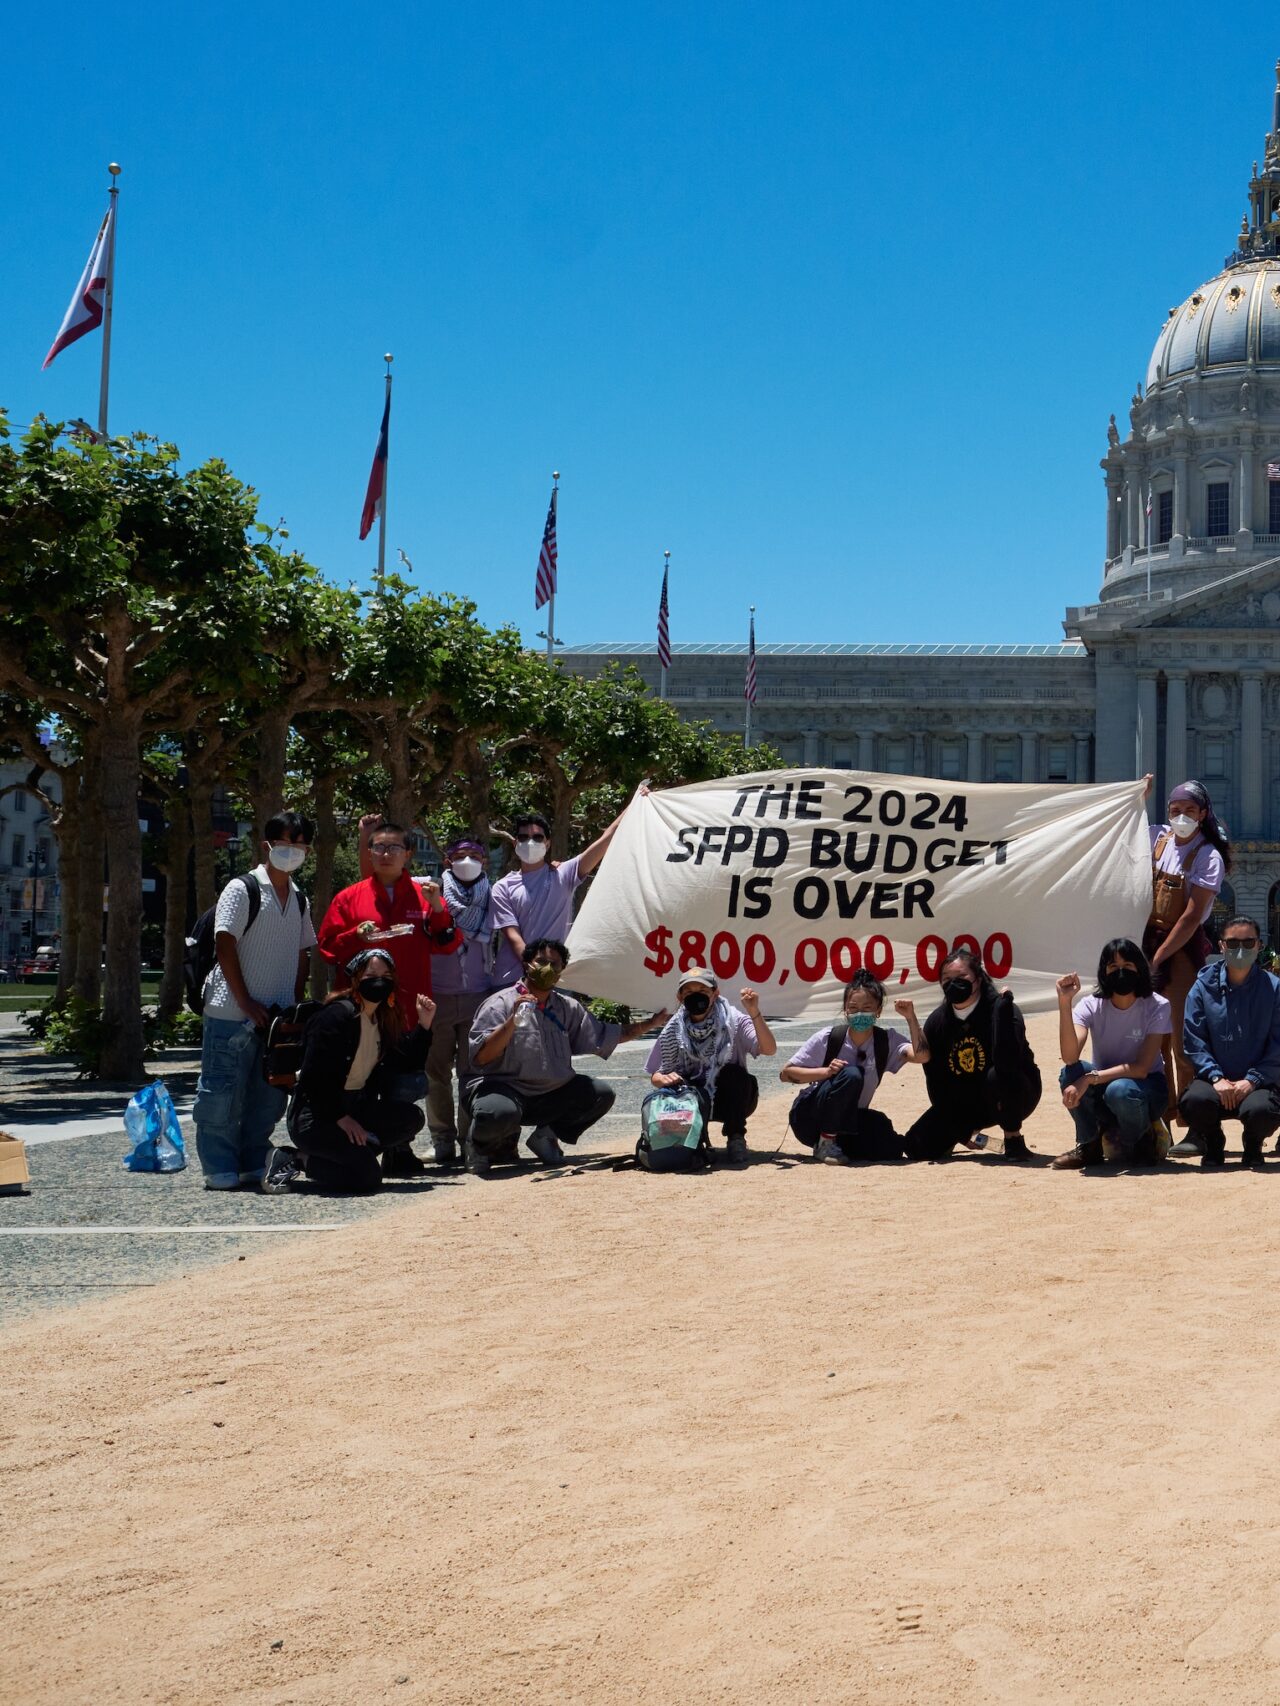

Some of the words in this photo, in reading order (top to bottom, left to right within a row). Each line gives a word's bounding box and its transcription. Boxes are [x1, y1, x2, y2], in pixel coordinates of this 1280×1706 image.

[732, 781, 825, 820] THE
[844, 786, 968, 831] 2024
[667, 826, 790, 868] SFPD
[811, 829, 1011, 874] BUDGET
[728, 876, 772, 918] IS
[794, 877, 935, 918] OVER
